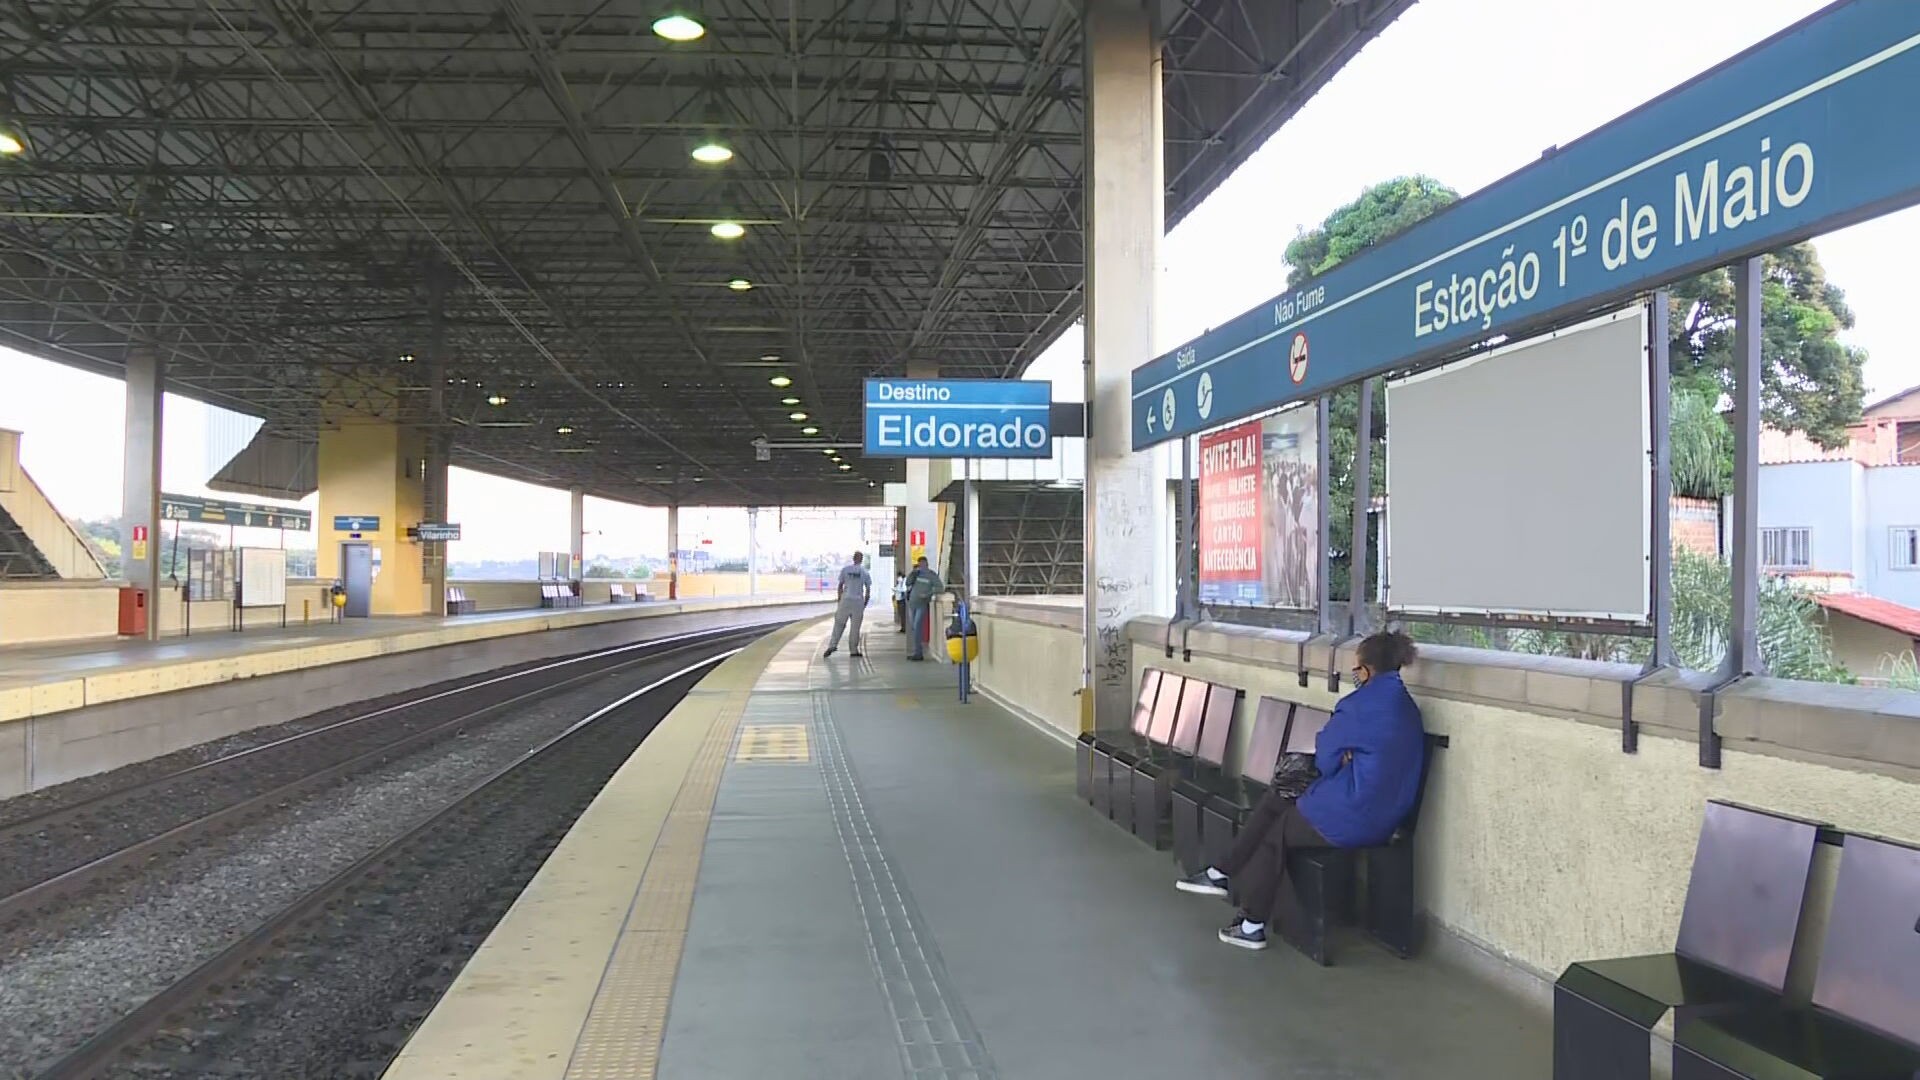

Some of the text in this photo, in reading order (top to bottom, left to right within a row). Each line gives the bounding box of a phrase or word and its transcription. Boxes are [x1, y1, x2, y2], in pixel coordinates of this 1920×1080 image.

[1414, 244, 1541, 338] Estação
[1602, 198, 1657, 271] de
[1674, 137, 1814, 246] Maio
[1275, 285, 1325, 325] Não Fume
[1176, 347, 1196, 370] Saída
[879, 383, 950, 400] Destino
[878, 415, 1047, 448] Eldorado
[1203, 433, 1256, 477] EVITE FILA!
[420, 530, 459, 540] Vilarinho
